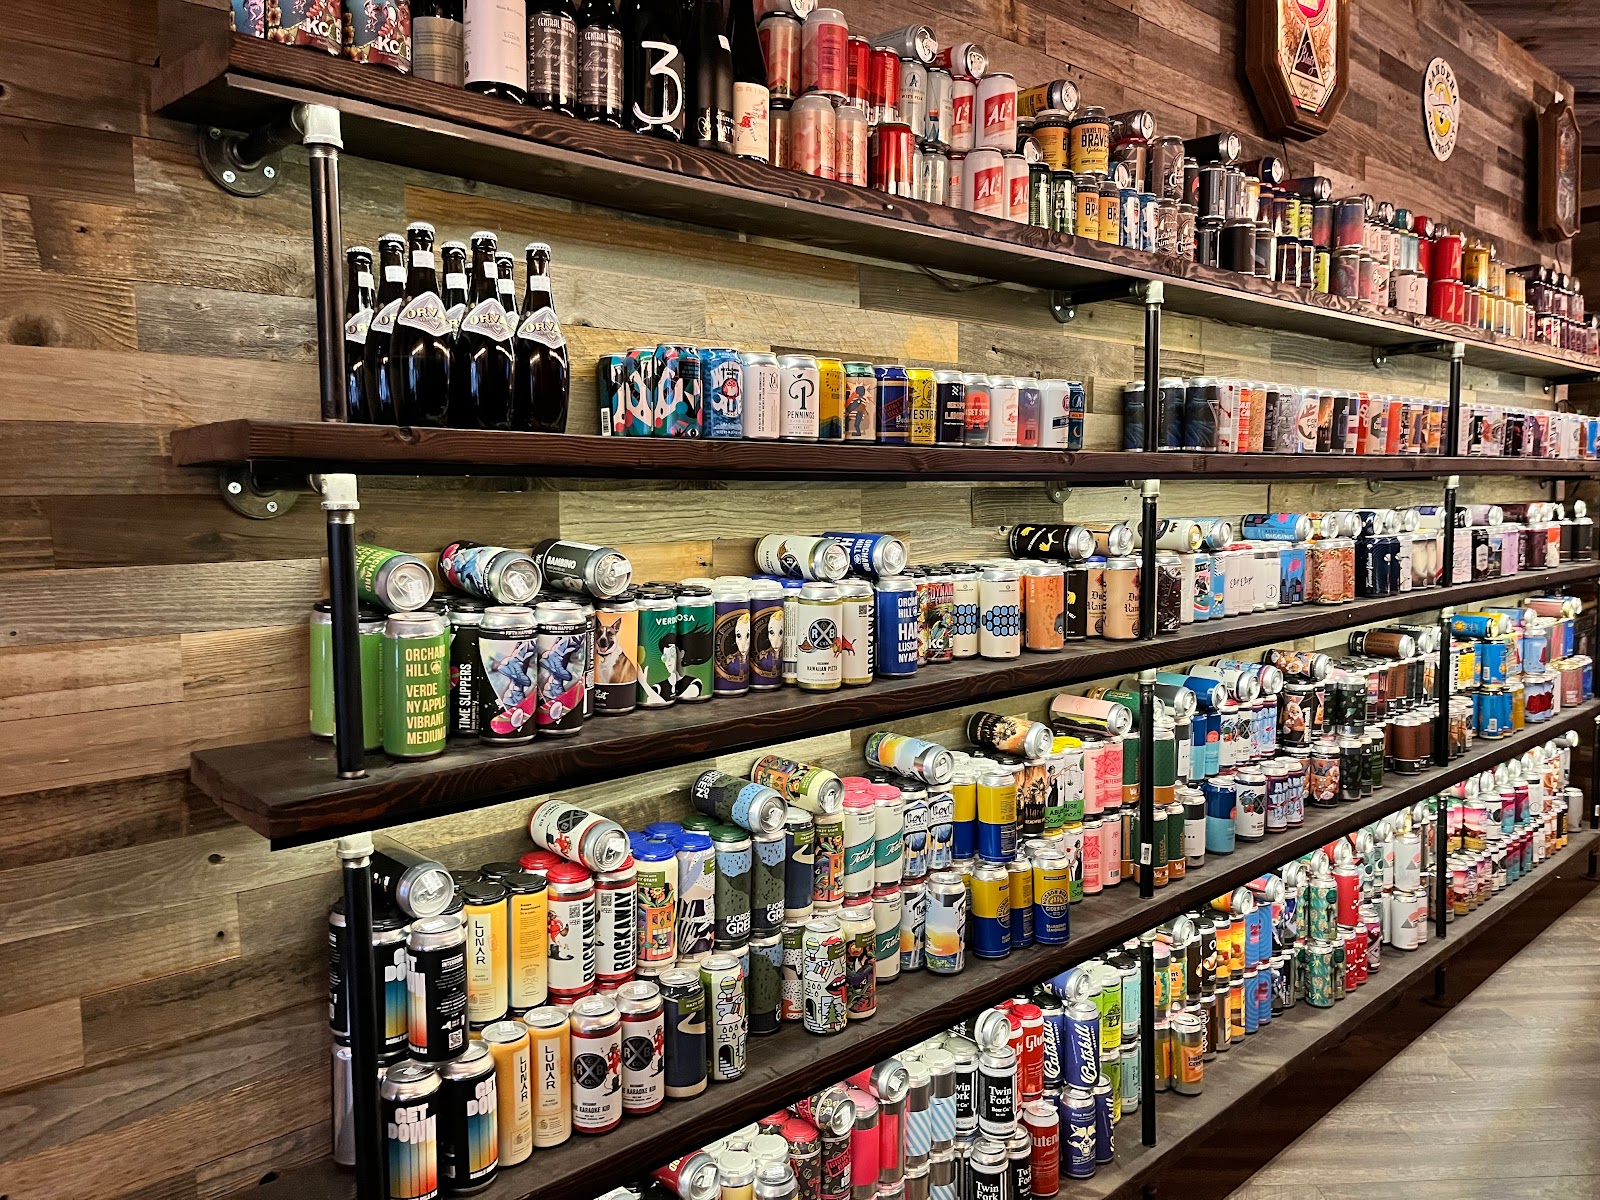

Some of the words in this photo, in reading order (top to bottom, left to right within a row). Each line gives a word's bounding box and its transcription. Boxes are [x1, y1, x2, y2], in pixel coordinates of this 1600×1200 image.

[537, 17, 560, 28] CENTRAL
[584, 31, 606, 42] CENTRAL
[632, 40, 683, 125] 3
[986, 98, 1014, 127] AL'S
[978, 171, 1002, 199] AL'S
[787, 410, 815, 420] PENNINGS
[854, 538, 865, 554] HILL
[546, 555, 577, 570] BAMBINO
[861, 539, 874, 572] ORCHARD
[898, 608, 912, 618] HILL
[811, 630, 818, 639] R
[829, 630, 835, 639] B
[405, 663, 430, 677] HILL
[405, 682, 438, 698] VERDE
[459, 663, 472, 706] SLIPPERS
[406, 700, 421, 713] NY
[406, 711, 444, 729] VIBRANT
[458, 707, 471, 730] TIME
[613, 891, 632, 973] ROCKAWAY
[475, 920, 486, 965] LUNAR
[582, 900, 596, 984] ROCKAWAY
[624, 1048, 631, 1059] R
[1080, 1023, 1097, 1085] Catskill
[545, 1045, 556, 1090] LUNAR
[576, 1064, 583, 1075] R
[475, 1072, 497, 1100] GET
[519, 1056, 529, 1103] LUNAR
[626, 1087, 648, 1095] KARAOKE
[648, 1085, 657, 1094] KID
[988, 1085, 1012, 1096] Twin
[989, 1095, 1012, 1105] Fork
[394, 1102, 429, 1125] GET
[579, 1105, 601, 1113] KARAOKE
[601, 1104, 611, 1112] KID
[387, 1114, 437, 1145] DOWN
[975, 1180, 1000, 1192] Twin
